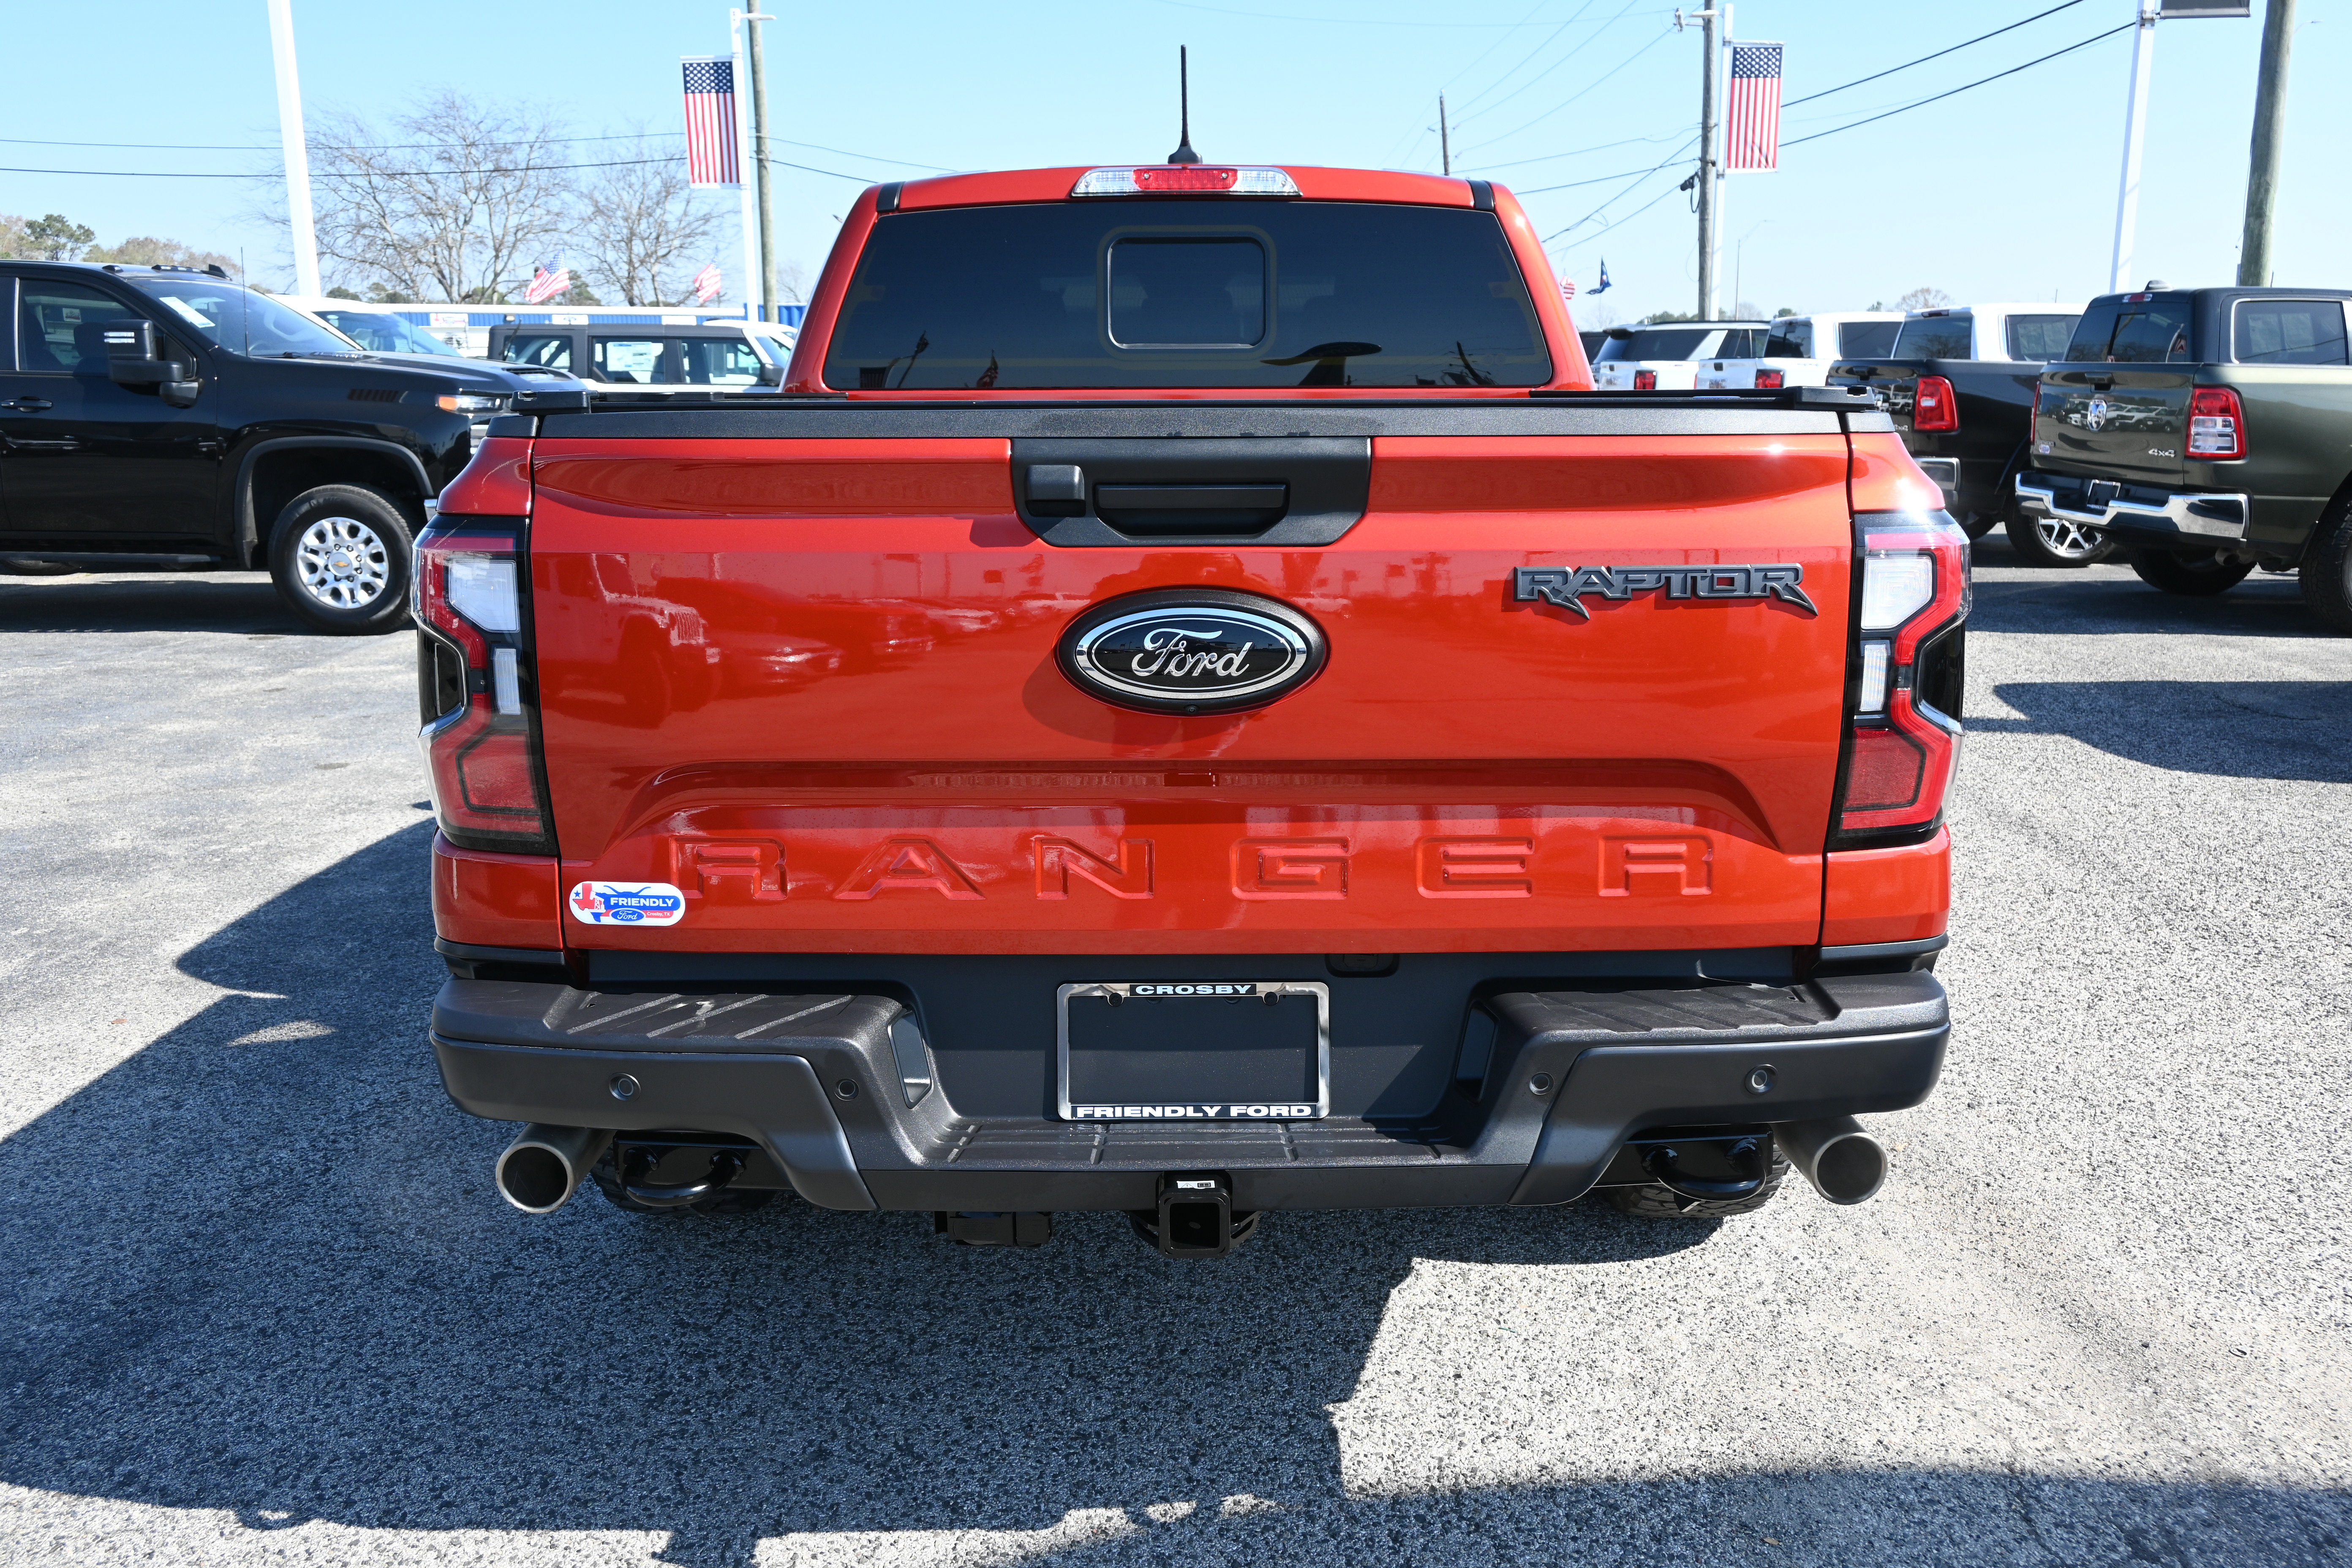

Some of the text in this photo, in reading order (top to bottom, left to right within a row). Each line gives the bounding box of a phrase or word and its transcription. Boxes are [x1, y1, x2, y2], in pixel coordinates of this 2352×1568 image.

[2148, 448, 2175, 457] 4x4
[1513, 563, 1818, 620] RAPTOR
[1131, 628, 1253, 677] Ford
[669, 835, 1714, 900] RANGER
[610, 897, 674, 906] FRIENDLY
[618, 910, 637, 920] Ford
[1135, 985, 1251, 995] CROSBY
[1077, 1106, 1312, 1117] FRIENDLY FORD
